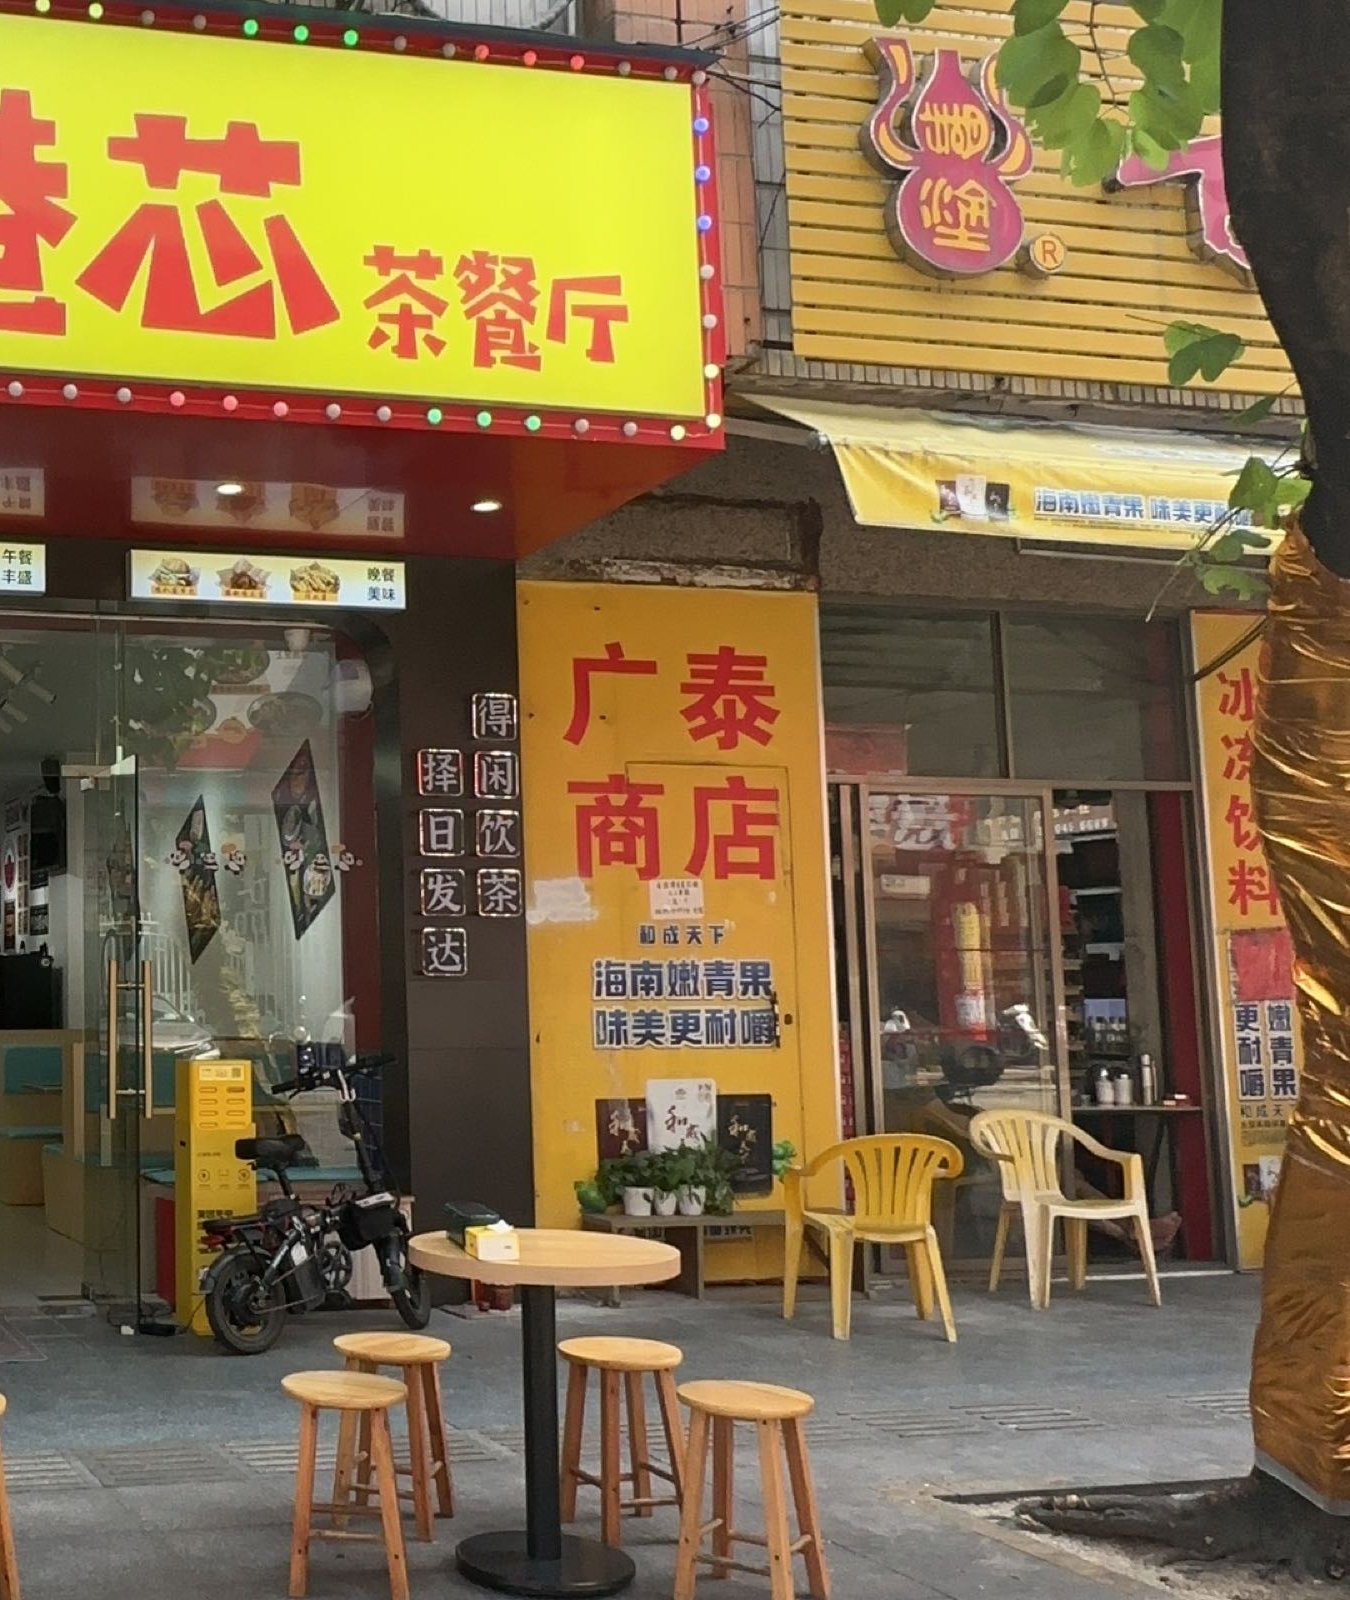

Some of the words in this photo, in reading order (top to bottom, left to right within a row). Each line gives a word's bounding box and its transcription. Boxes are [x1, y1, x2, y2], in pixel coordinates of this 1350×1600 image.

[362, 243, 630, 372] 茶餐厅
[1036, 490, 1144, 518] 海南嫩青果
[2, 548, 32, 566] 午餐
[367, 566, 395, 583] 晚餐
[2, 569, 32, 585] 丰盛
[367, 586, 396, 602] 美味
[563, 641, 781, 750] 广泰
[478, 698, 520, 913] 得闲饮茶
[566, 774, 781, 881] 商店
[422, 754, 465, 974] 择日发达
[639, 925, 725, 946] 和成天下
[593, 960, 773, 999] 海南嫩青果
[594, 1009, 779, 1049] 味美更耐嚼
[1235, 1004, 1265, 1096] 更耐嚼
[1240, 1103, 1296, 1119] 和成天
